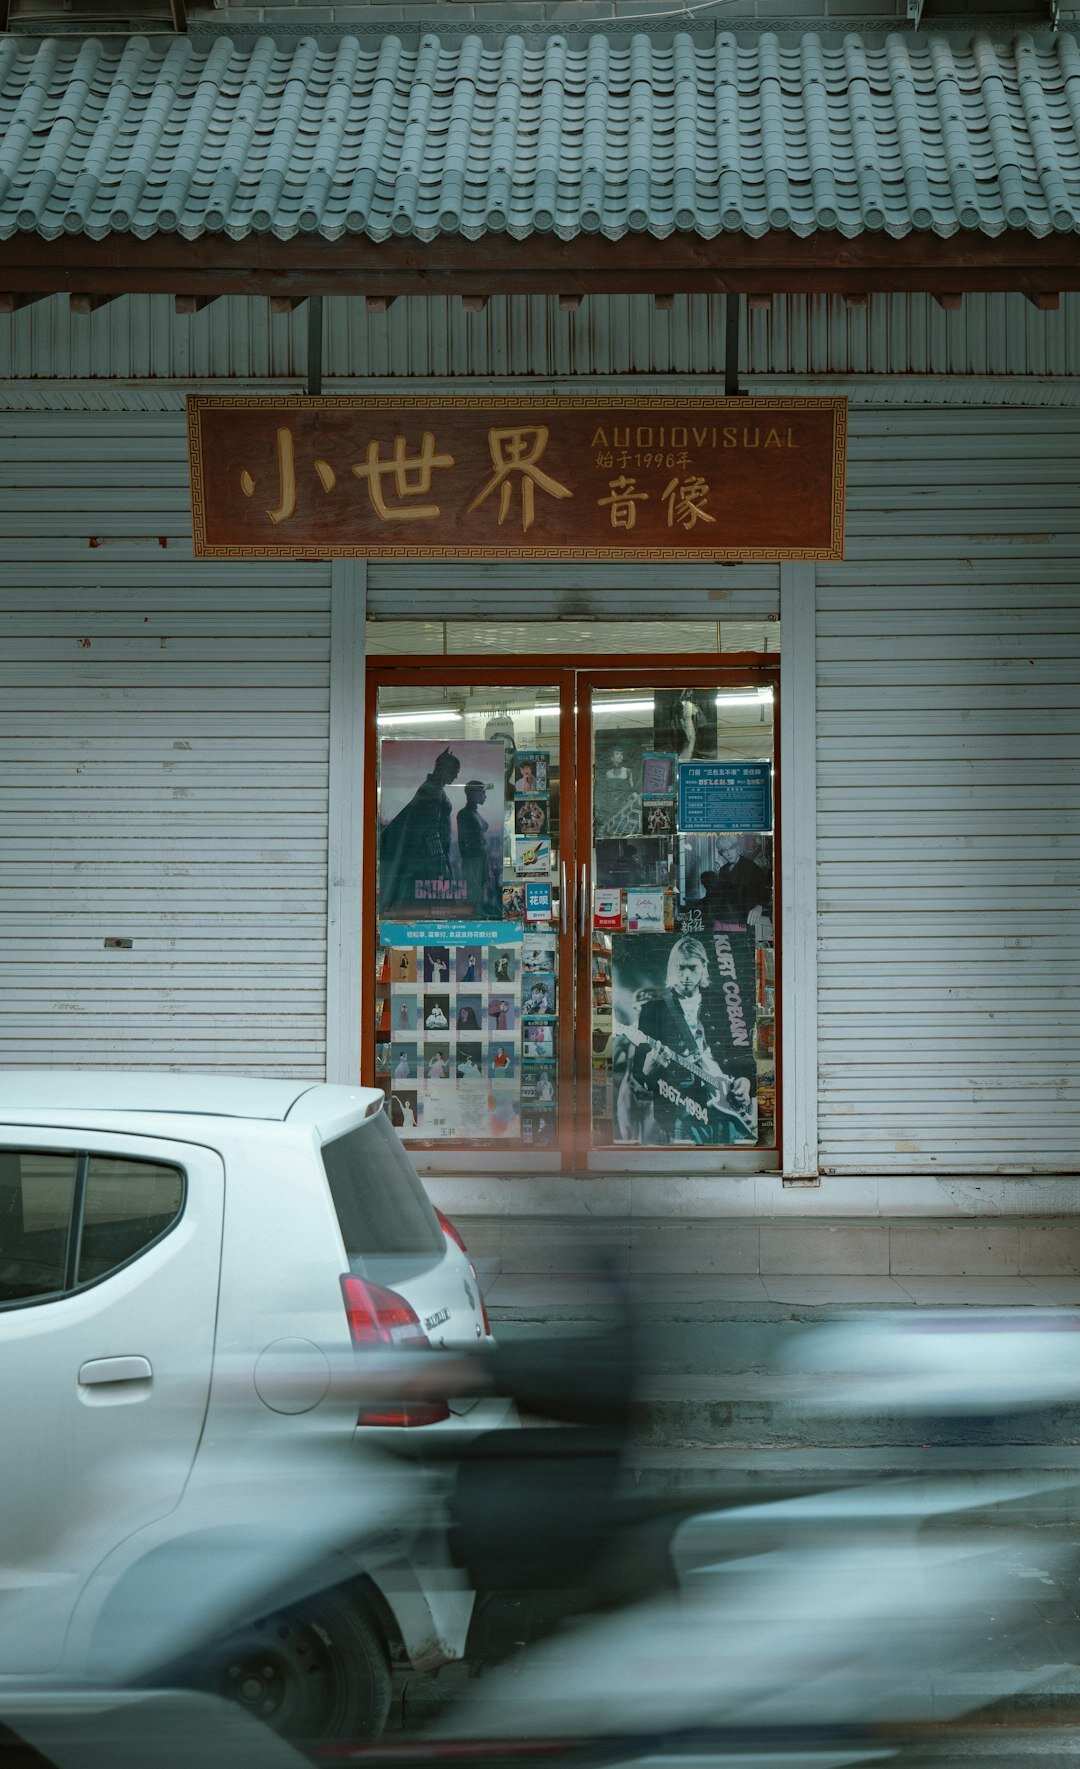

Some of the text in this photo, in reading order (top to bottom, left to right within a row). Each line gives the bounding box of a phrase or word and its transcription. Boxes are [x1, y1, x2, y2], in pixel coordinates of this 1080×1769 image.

[595, 451, 692, 470] 始于1996年
[240, 427, 574, 532] 小世界
[597, 475, 716, 530] 音像
[415, 879, 467, 899] BATMAN
[529, 895, 549, 906] 花呗
[687, 909, 702, 922] 12
[713, 934, 750, 1046] KURT COBAIN
